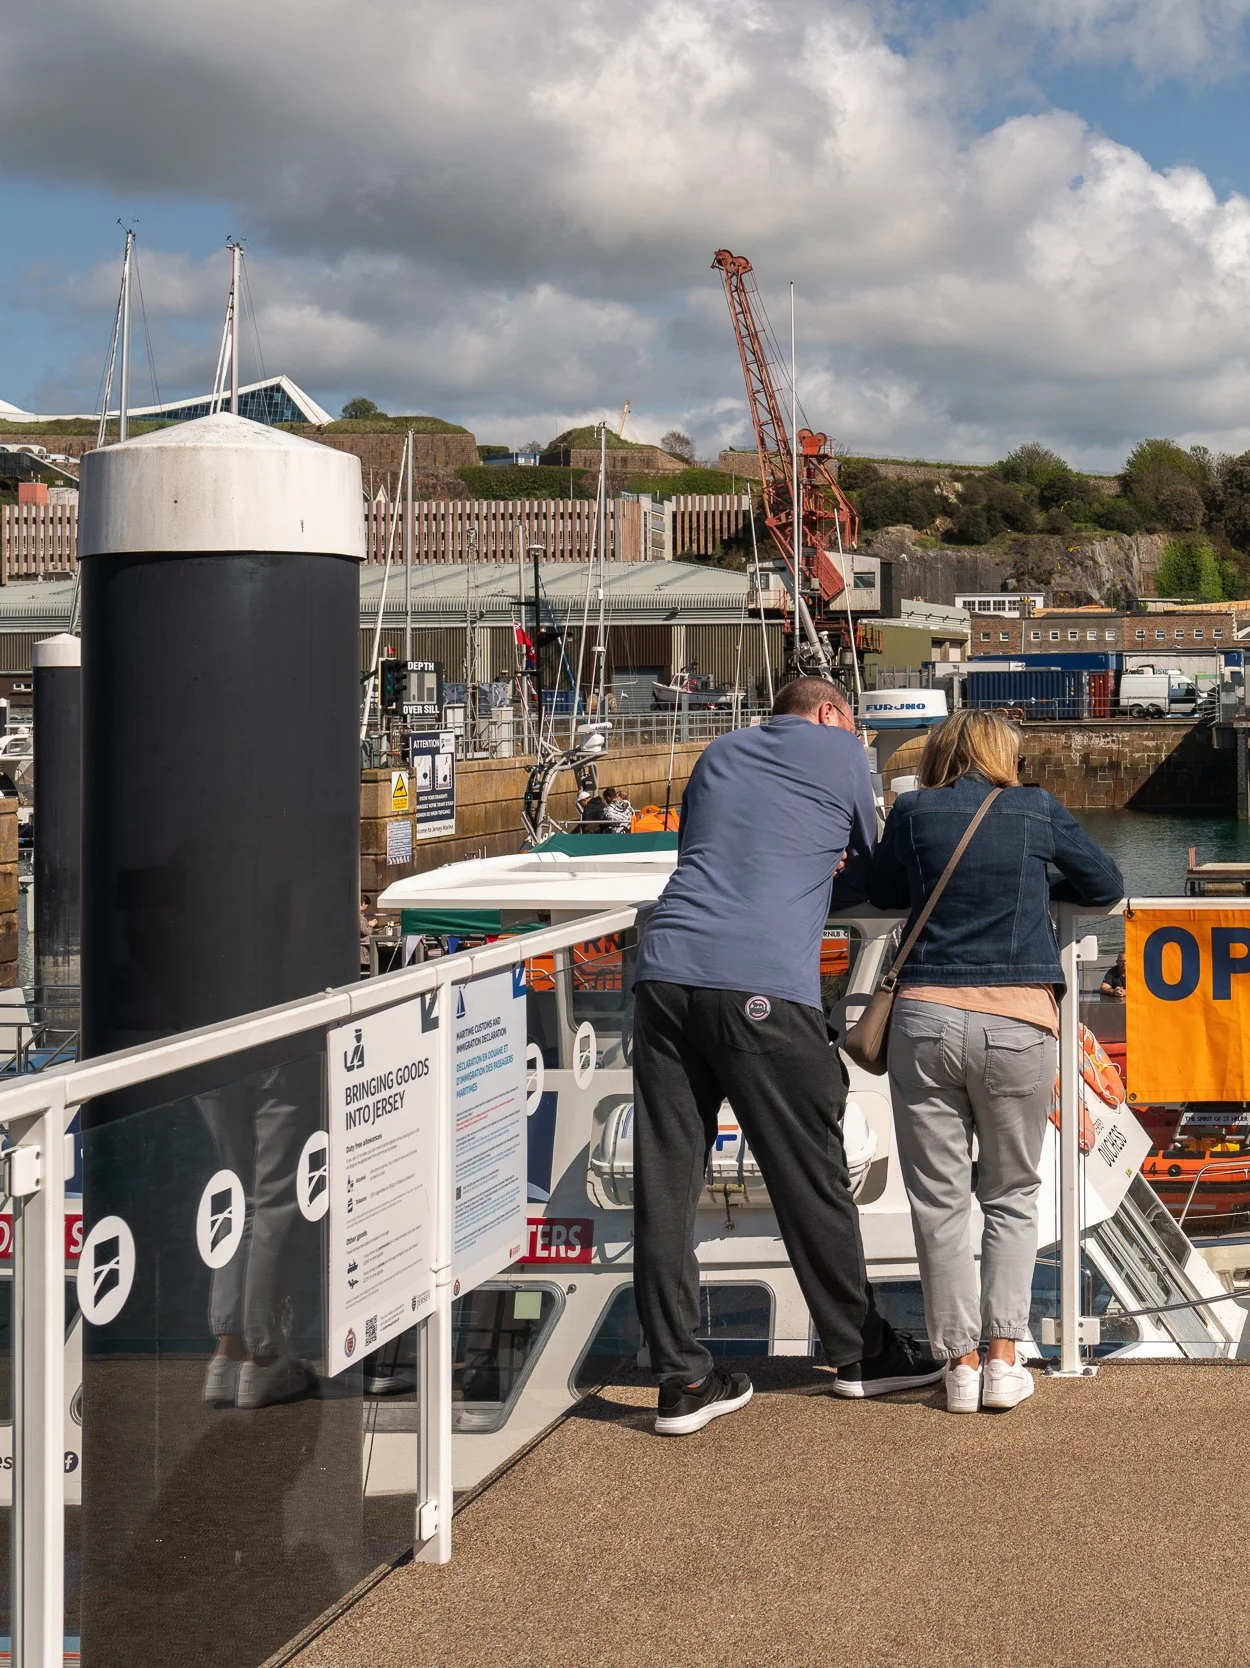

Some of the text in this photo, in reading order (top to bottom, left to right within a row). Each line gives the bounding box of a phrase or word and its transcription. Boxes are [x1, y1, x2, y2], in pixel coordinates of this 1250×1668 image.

[407, 661, 434, 671] DEPTH
[403, 704, 440, 714] OVER SILL
[865, 703, 926, 712] FURUNO
[413, 738, 440, 749] ATTENTION
[431, 825, 442, 834] Jersey
[456, 1016, 501, 1040] MARITIME CUSTOMS AND
[456, 1027, 507, 1054] IMMIGRATION DECLARATION
[487, 1046, 503, 1060] DOUANE
[485, 1062, 493, 1073] DES
[345, 1057, 430, 1106] BRINGING GOODS
[345, 1089, 406, 1131] INTO JERSEY
[345, 1133, 382, 1154] Duty free allowances
[1097, 1124, 1127, 1168] DUCHESS
[345, 1235, 356, 1246] Other
[356, 1230, 368, 1242] goods
